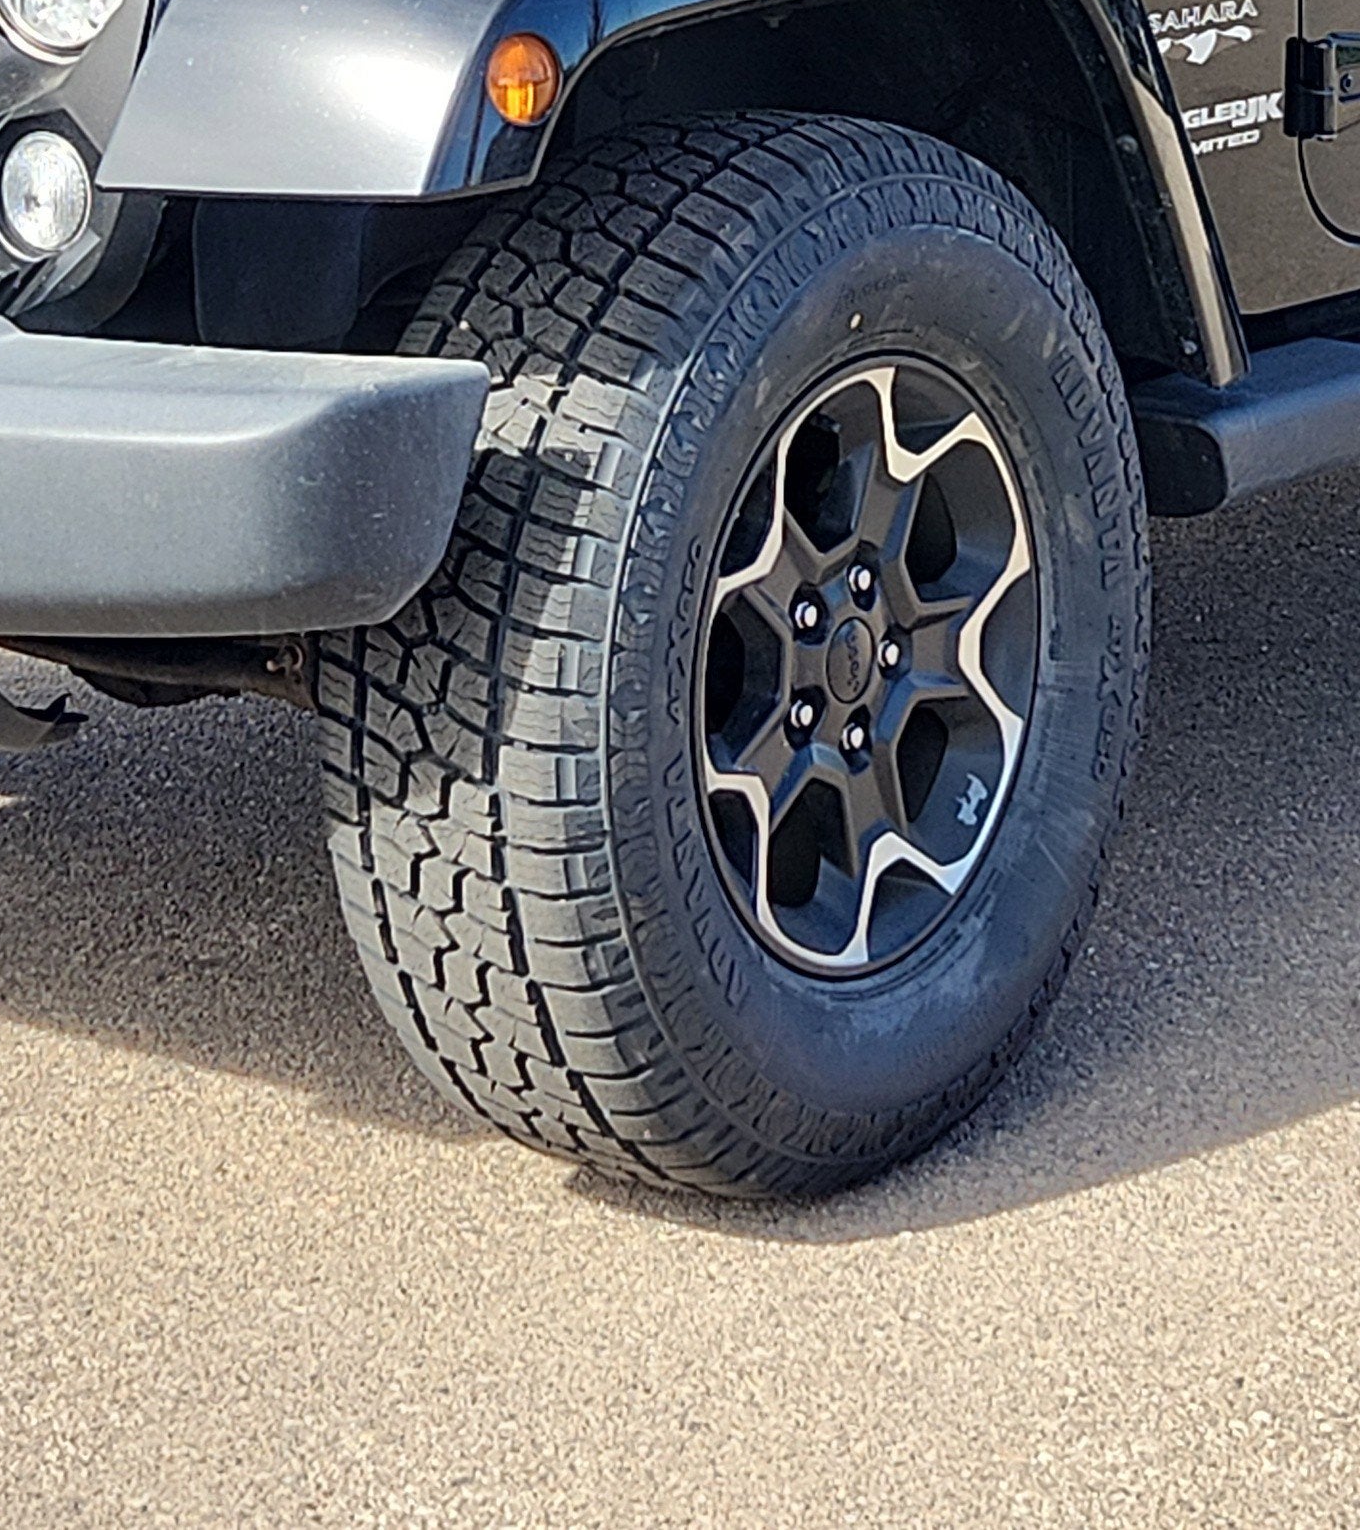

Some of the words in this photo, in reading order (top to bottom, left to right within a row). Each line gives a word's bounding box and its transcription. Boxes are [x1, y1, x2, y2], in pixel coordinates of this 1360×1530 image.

[1191, 129, 1261, 155] MITED
[1051, 345, 1123, 590] ADVANTA
[663, 749, 747, 1008] ADVANTA
